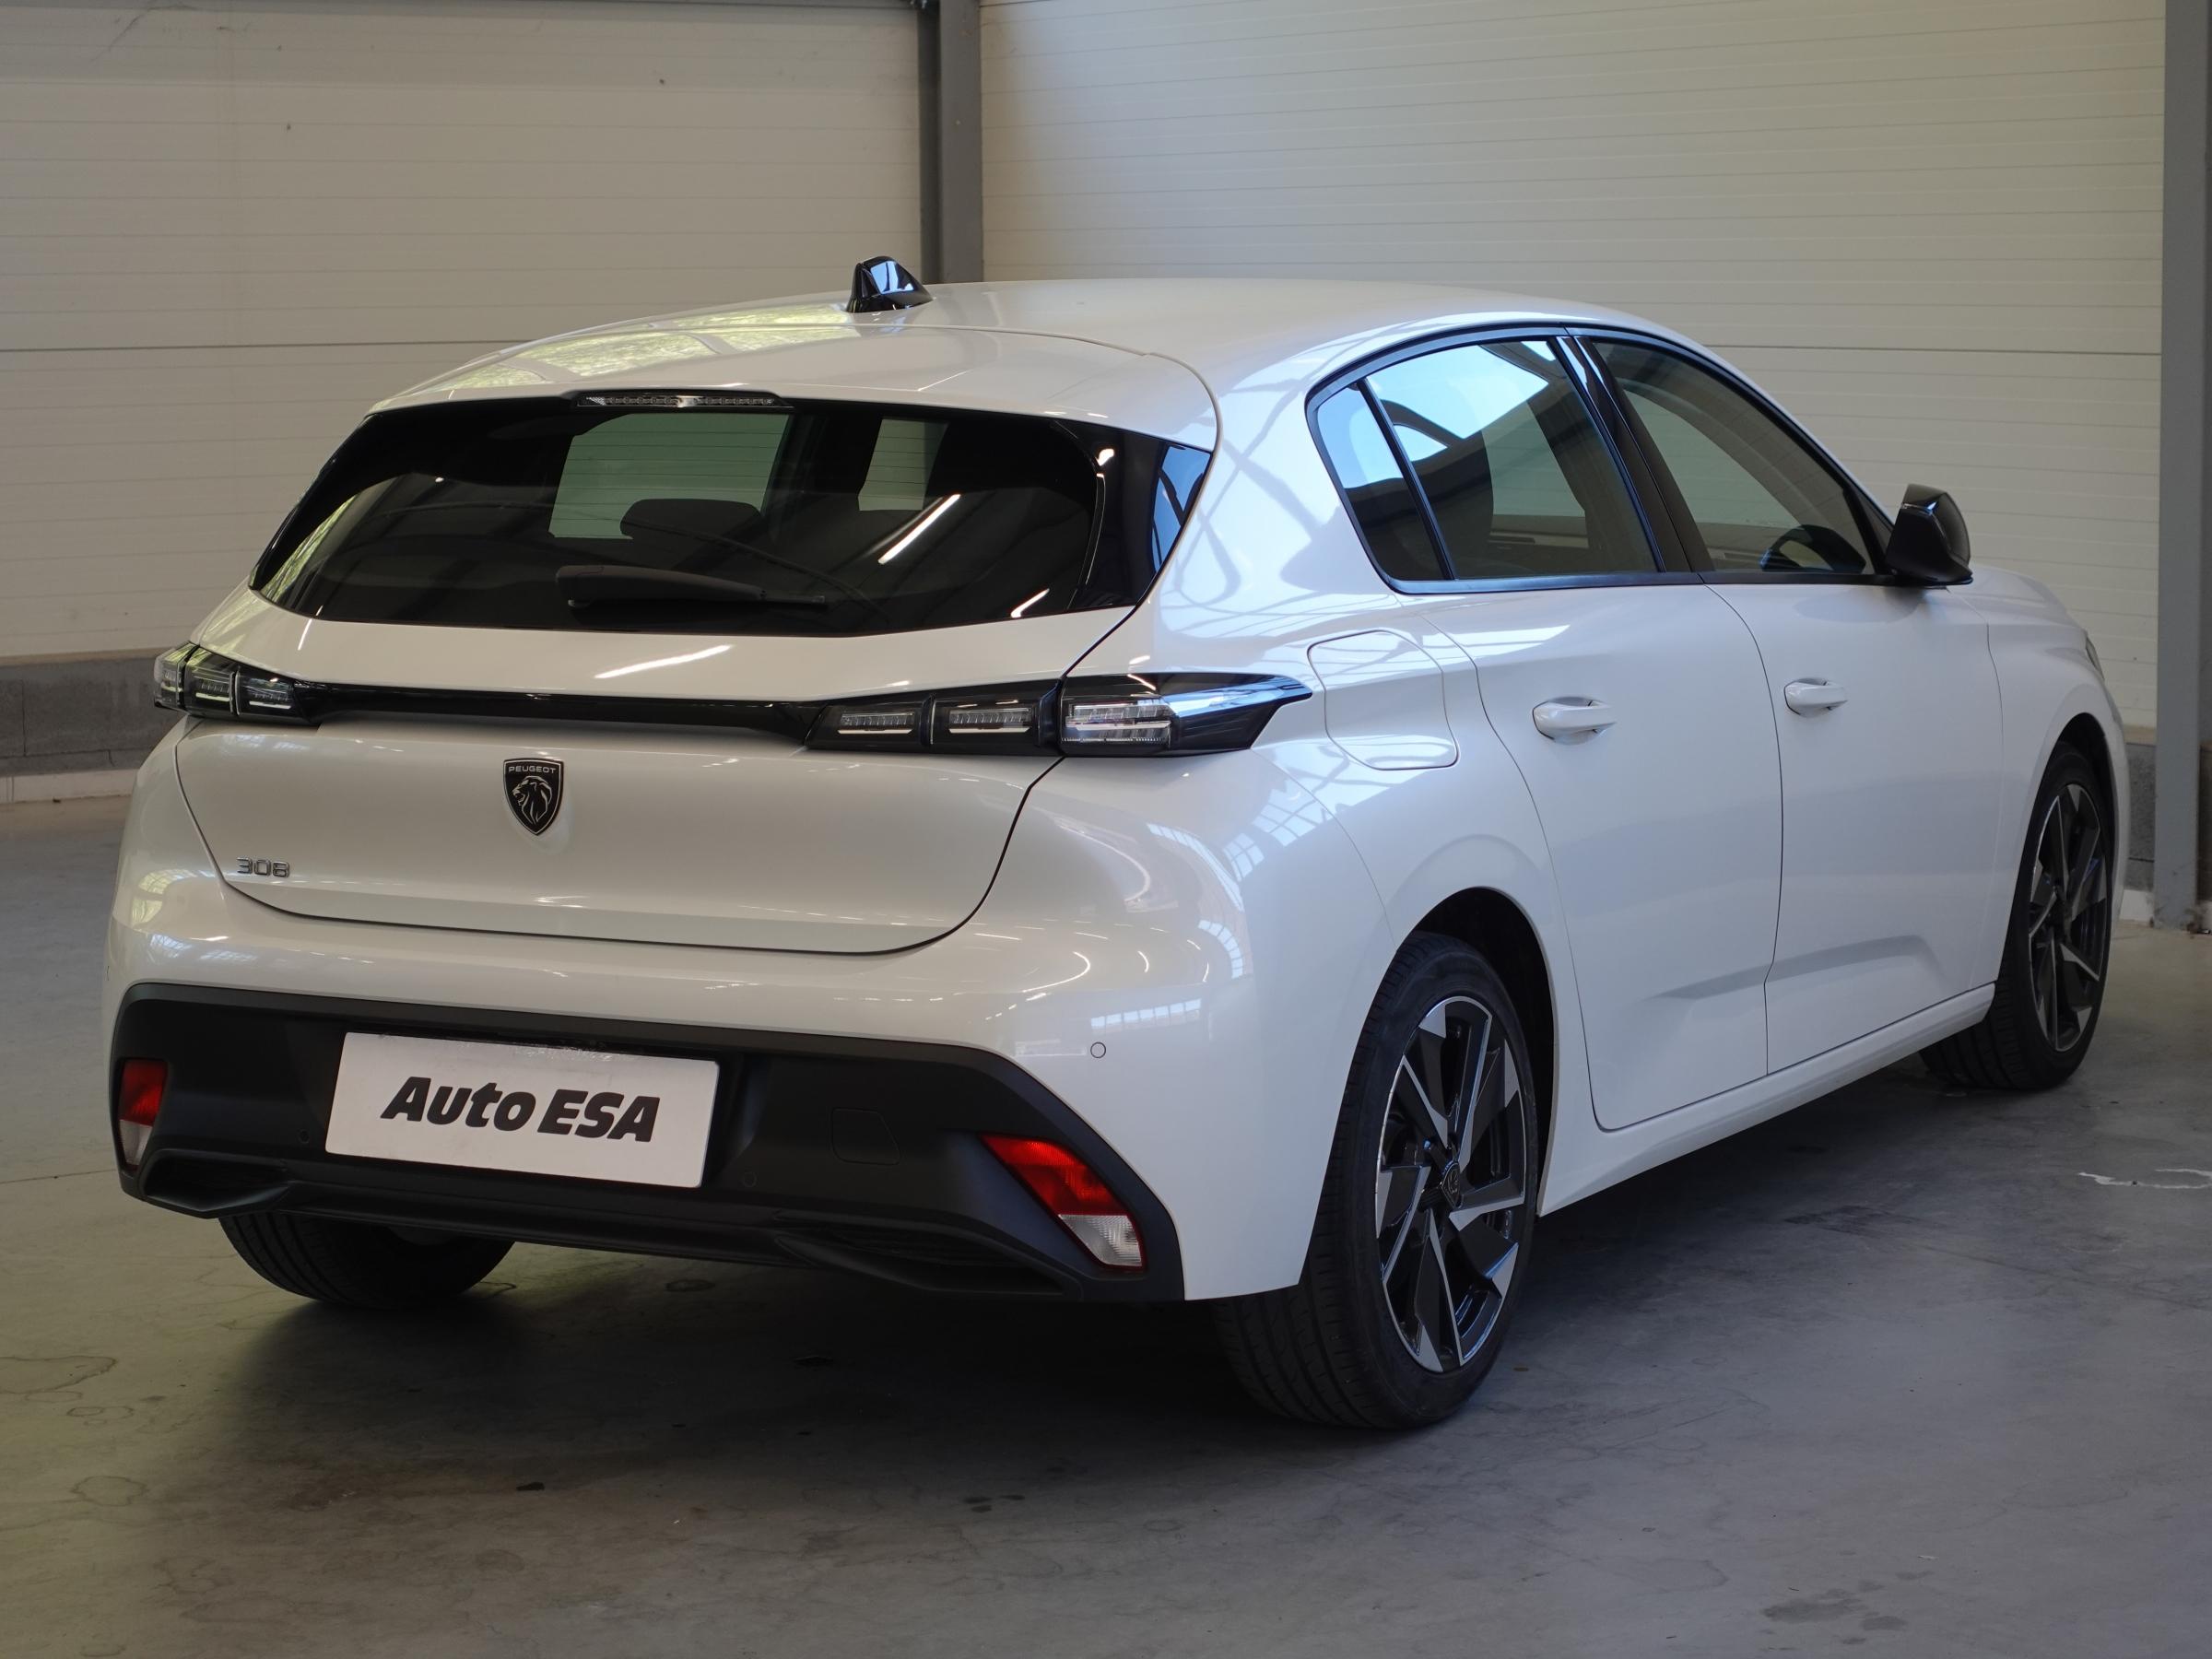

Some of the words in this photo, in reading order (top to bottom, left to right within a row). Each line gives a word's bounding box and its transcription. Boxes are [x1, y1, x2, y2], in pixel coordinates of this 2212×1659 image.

[508, 765, 557, 774] PEUGEOT
[236, 857, 290, 878] 308
[381, 1077, 536, 1132] Auto
[537, 1088, 661, 1143] ESA
